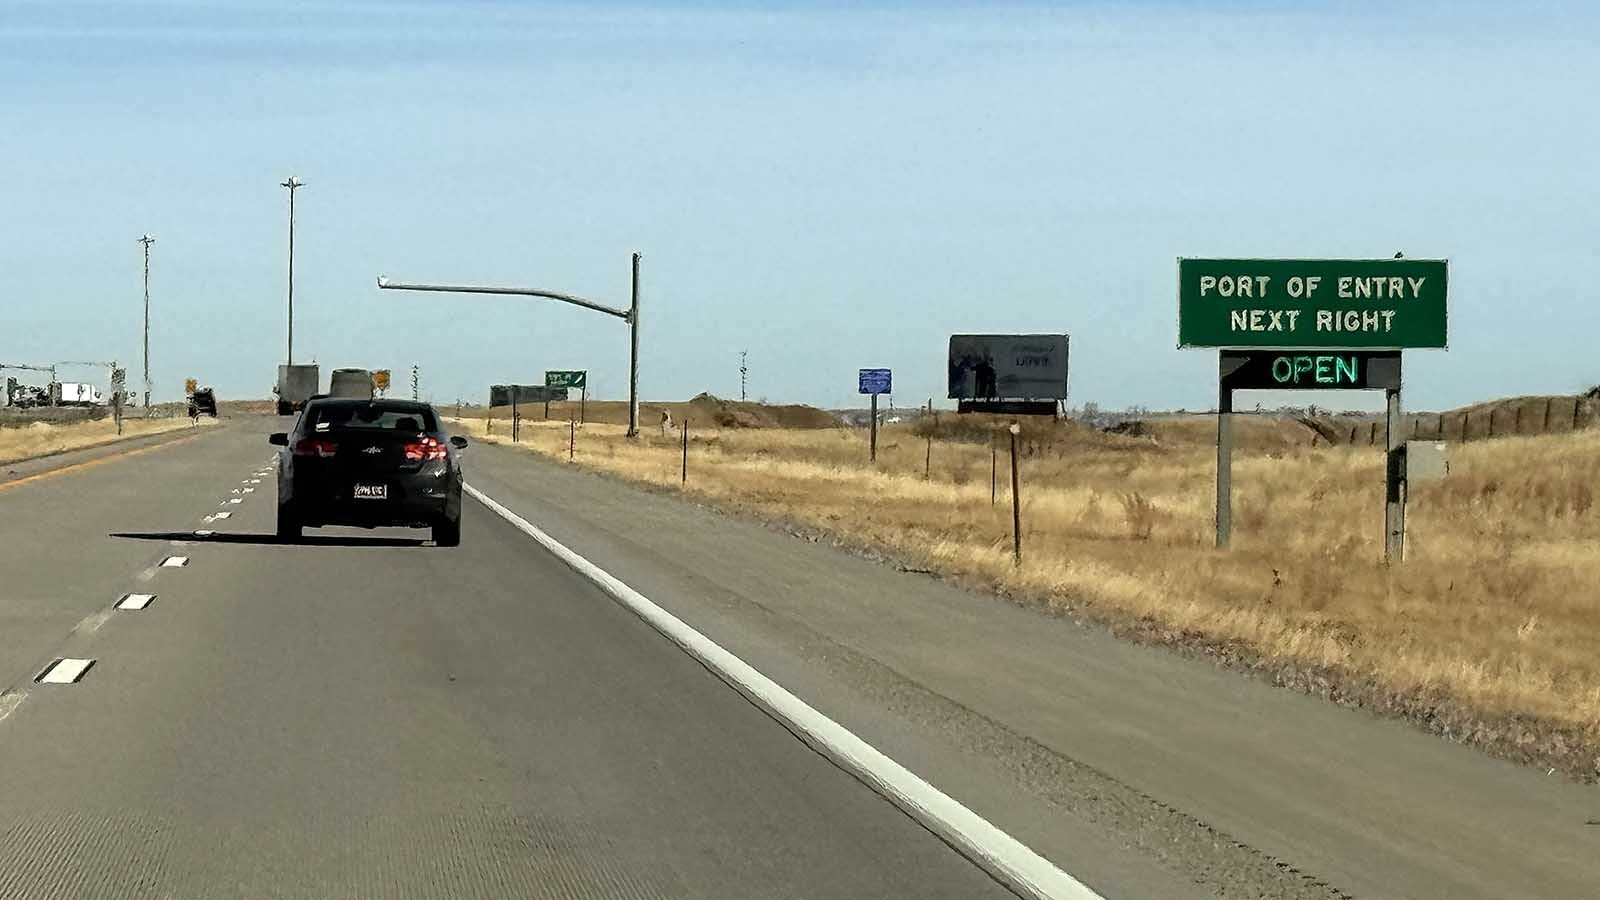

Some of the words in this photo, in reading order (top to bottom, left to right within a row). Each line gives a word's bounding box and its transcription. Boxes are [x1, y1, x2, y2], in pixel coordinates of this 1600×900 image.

[1200, 275, 1271, 298] PORT
[1286, 276, 1322, 298] OF
[1338, 276, 1427, 299] ENTRY
[1231, 309, 1301, 332] NEXT
[1316, 310, 1397, 333] RIGHT
[1272, 356, 1358, 383] OPEN
